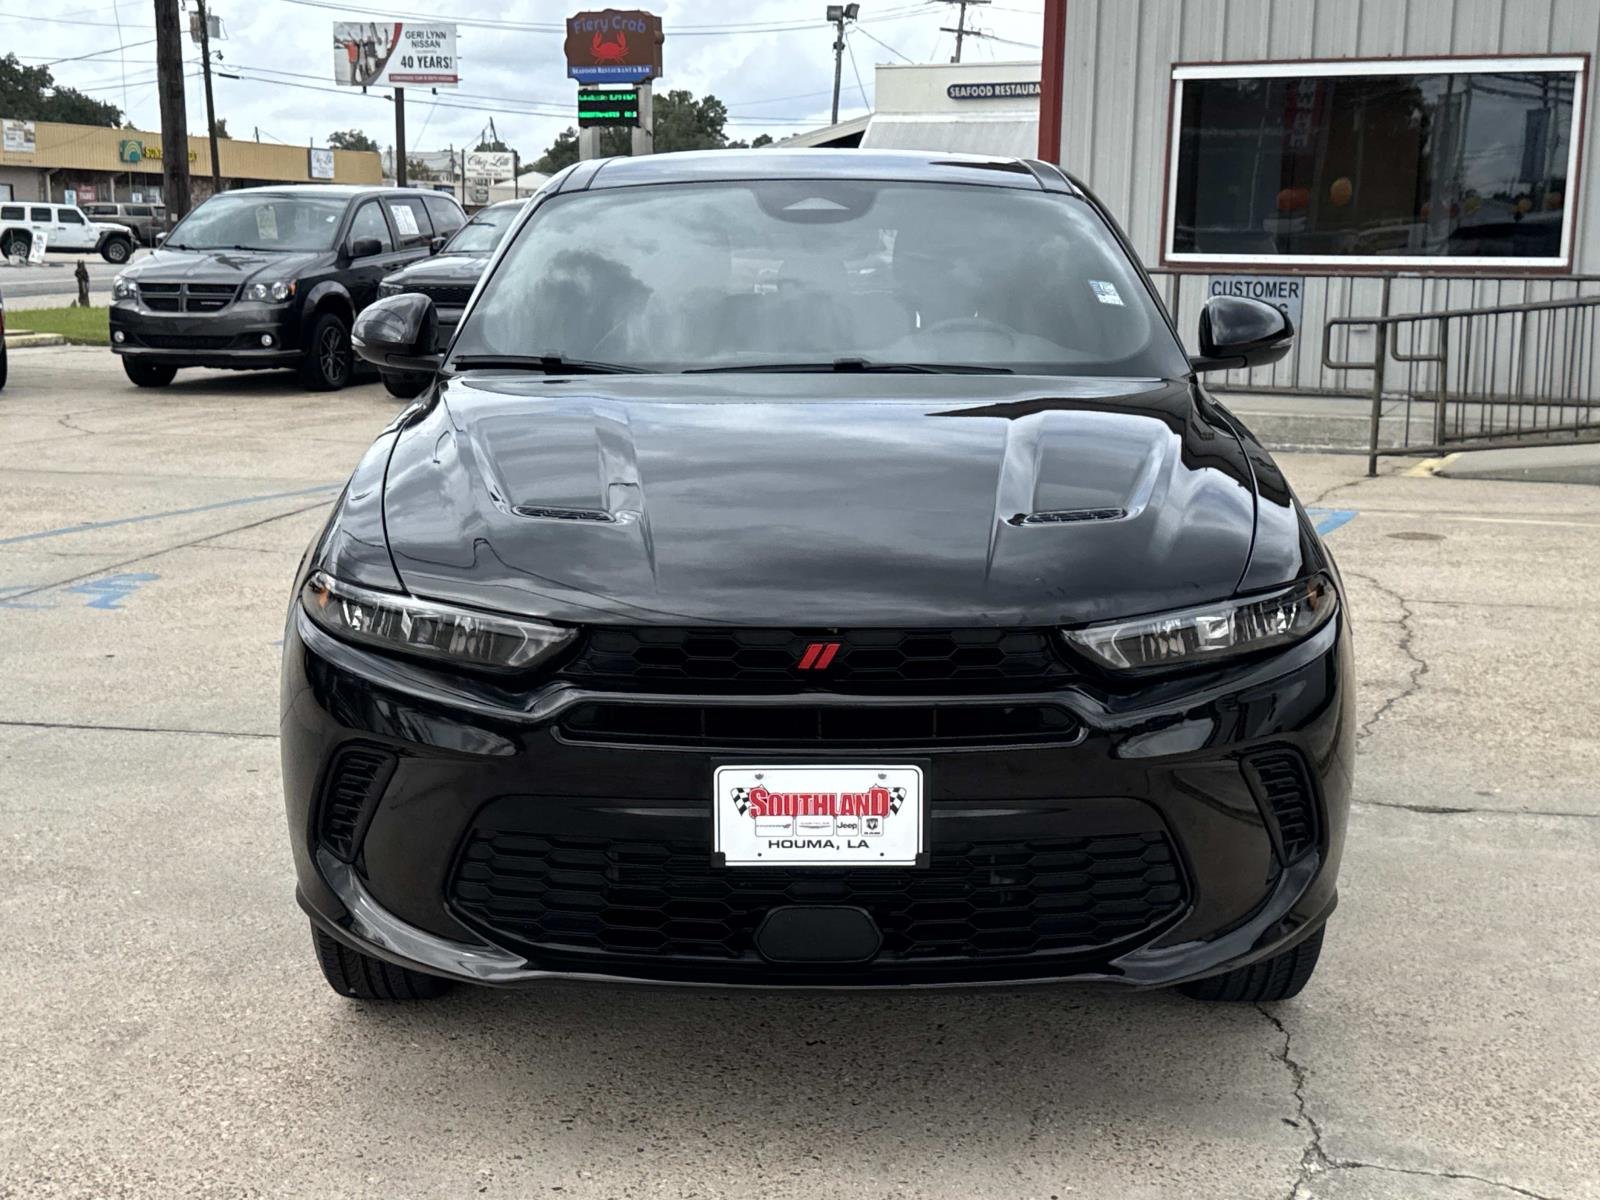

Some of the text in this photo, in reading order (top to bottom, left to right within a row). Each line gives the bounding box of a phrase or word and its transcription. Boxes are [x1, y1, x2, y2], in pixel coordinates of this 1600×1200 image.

[573, 16, 646, 33] Fiery Crab
[405, 31, 446, 39] GERI LYNN
[412, 40, 441, 48] NISSAN
[401, 55, 453, 69] 40 YEARS!
[949, 84, 1040, 97] SEAFOOD RESTAURA
[1211, 280, 1299, 298] CUSTOMER
[748, 786, 890, 818] SOUTHLAND
[836, 821, 858, 830] Jeep
[768, 839, 870, 850] HOUMA, LA
